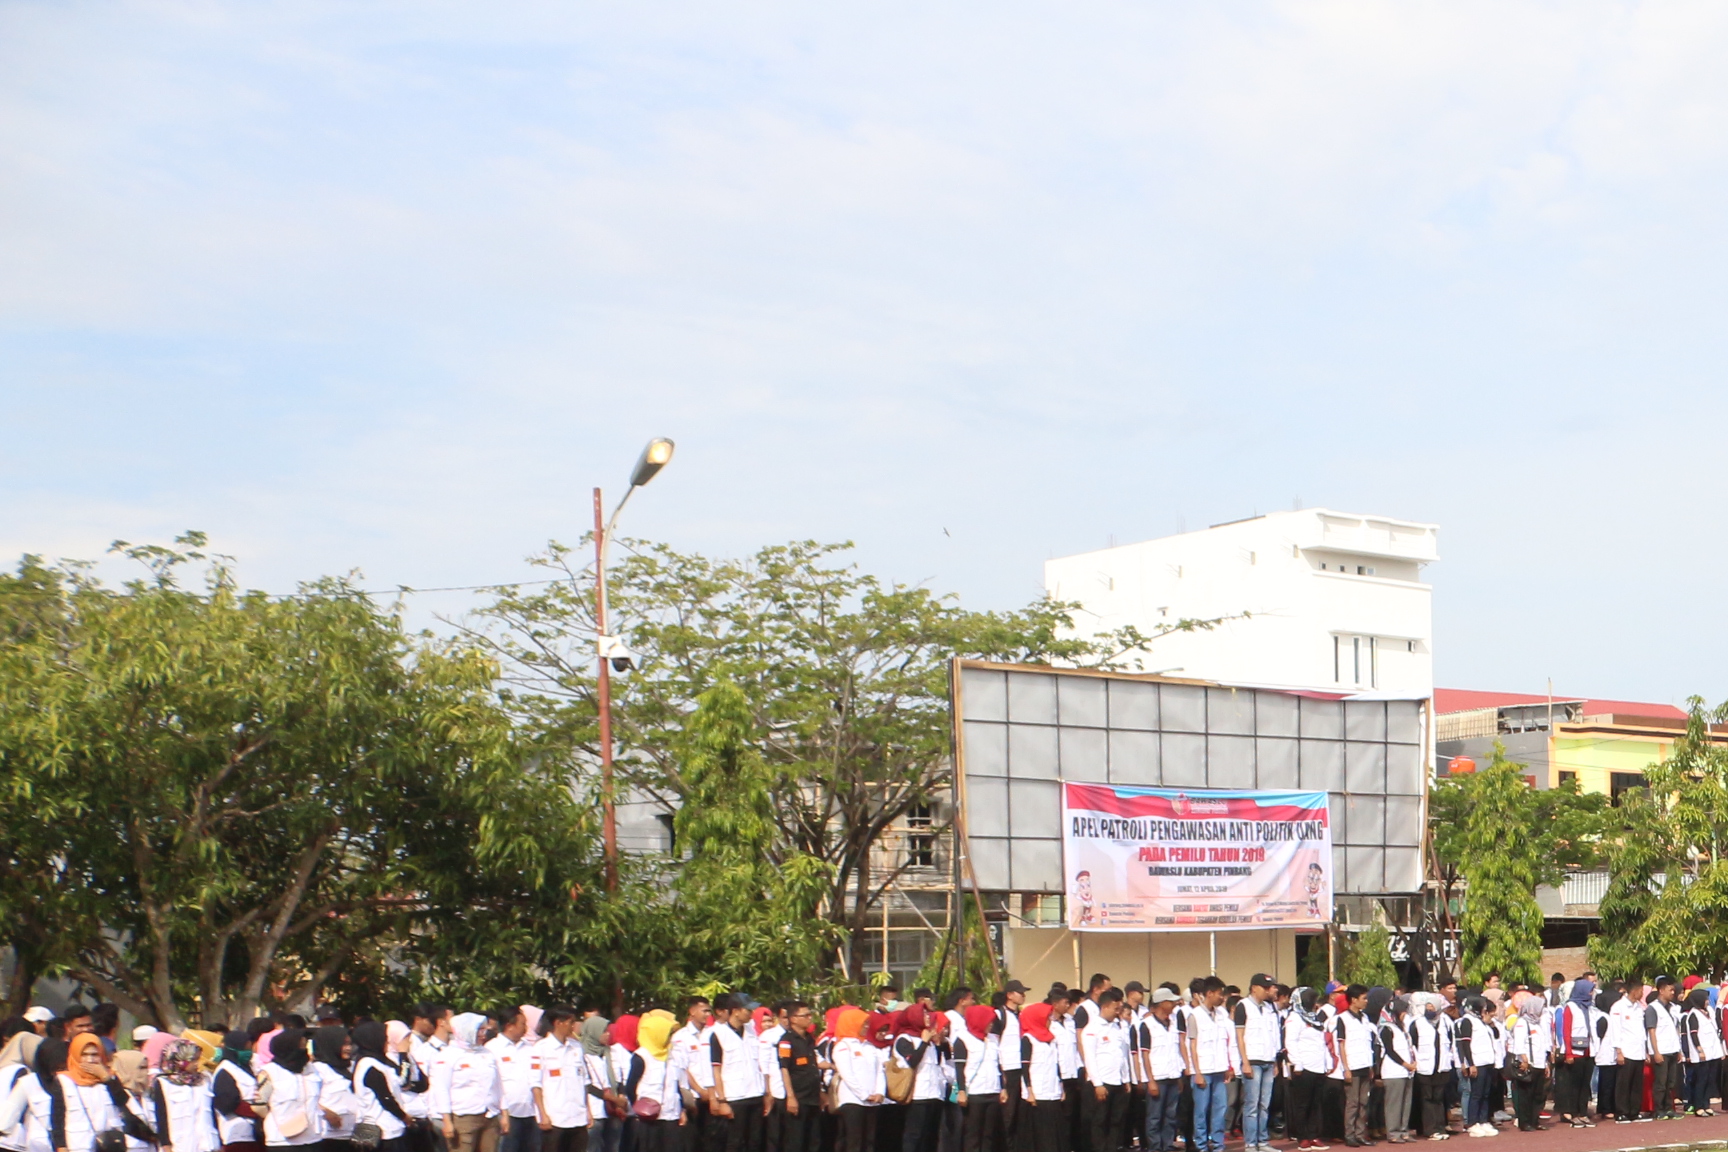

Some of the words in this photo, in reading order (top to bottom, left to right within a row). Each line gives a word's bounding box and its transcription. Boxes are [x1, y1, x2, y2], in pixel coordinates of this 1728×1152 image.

[1073, 817, 1100, 838] APEL
[1101, 819, 1147, 840] PATROLI
[1150, 820, 1226, 841] PENGAWASAN
[1230, 821, 1253, 841] ANTI
[1256, 822, 1294, 841] POLITIK
[1138, 847, 1166, 862] PADA
[1169, 847, 1206, 862] PEMILU
[1208, 847, 1240, 862] TAHUN
[1242, 847, 1265, 862] 2019
[1184, 867, 1222, 876] KABUPATEN
